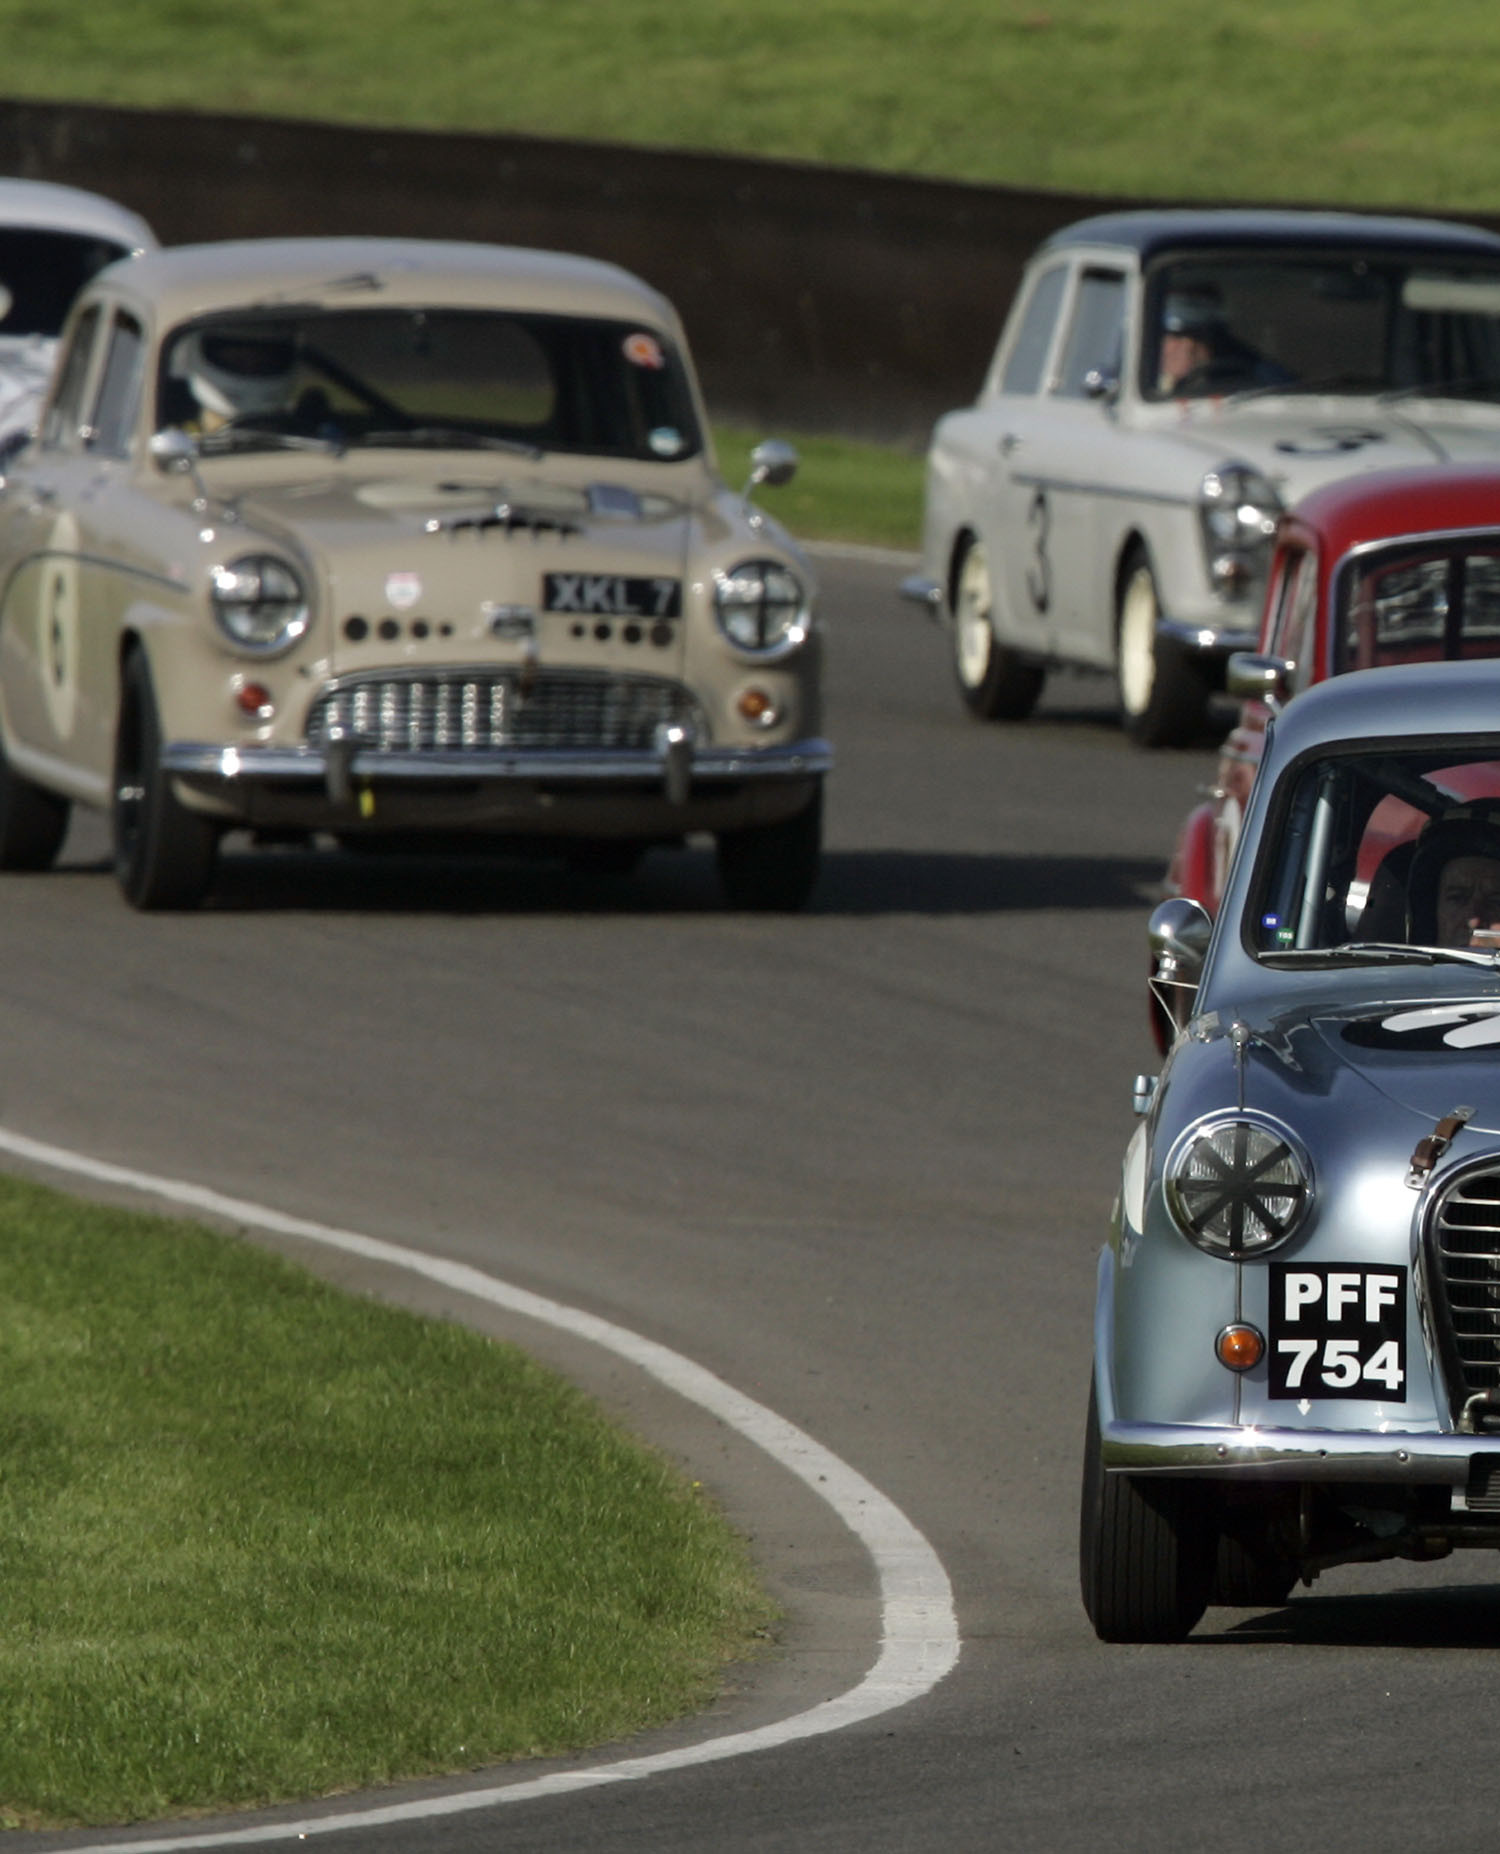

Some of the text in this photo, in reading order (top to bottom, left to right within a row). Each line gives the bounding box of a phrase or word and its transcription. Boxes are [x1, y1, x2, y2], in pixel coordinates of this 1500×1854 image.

[1025, 486, 1053, 616] 3
[552, 574, 675, 613] XKL 7
[1285, 1273, 1399, 1322] PFF
[1278, 1339, 1404, 1390] 754
